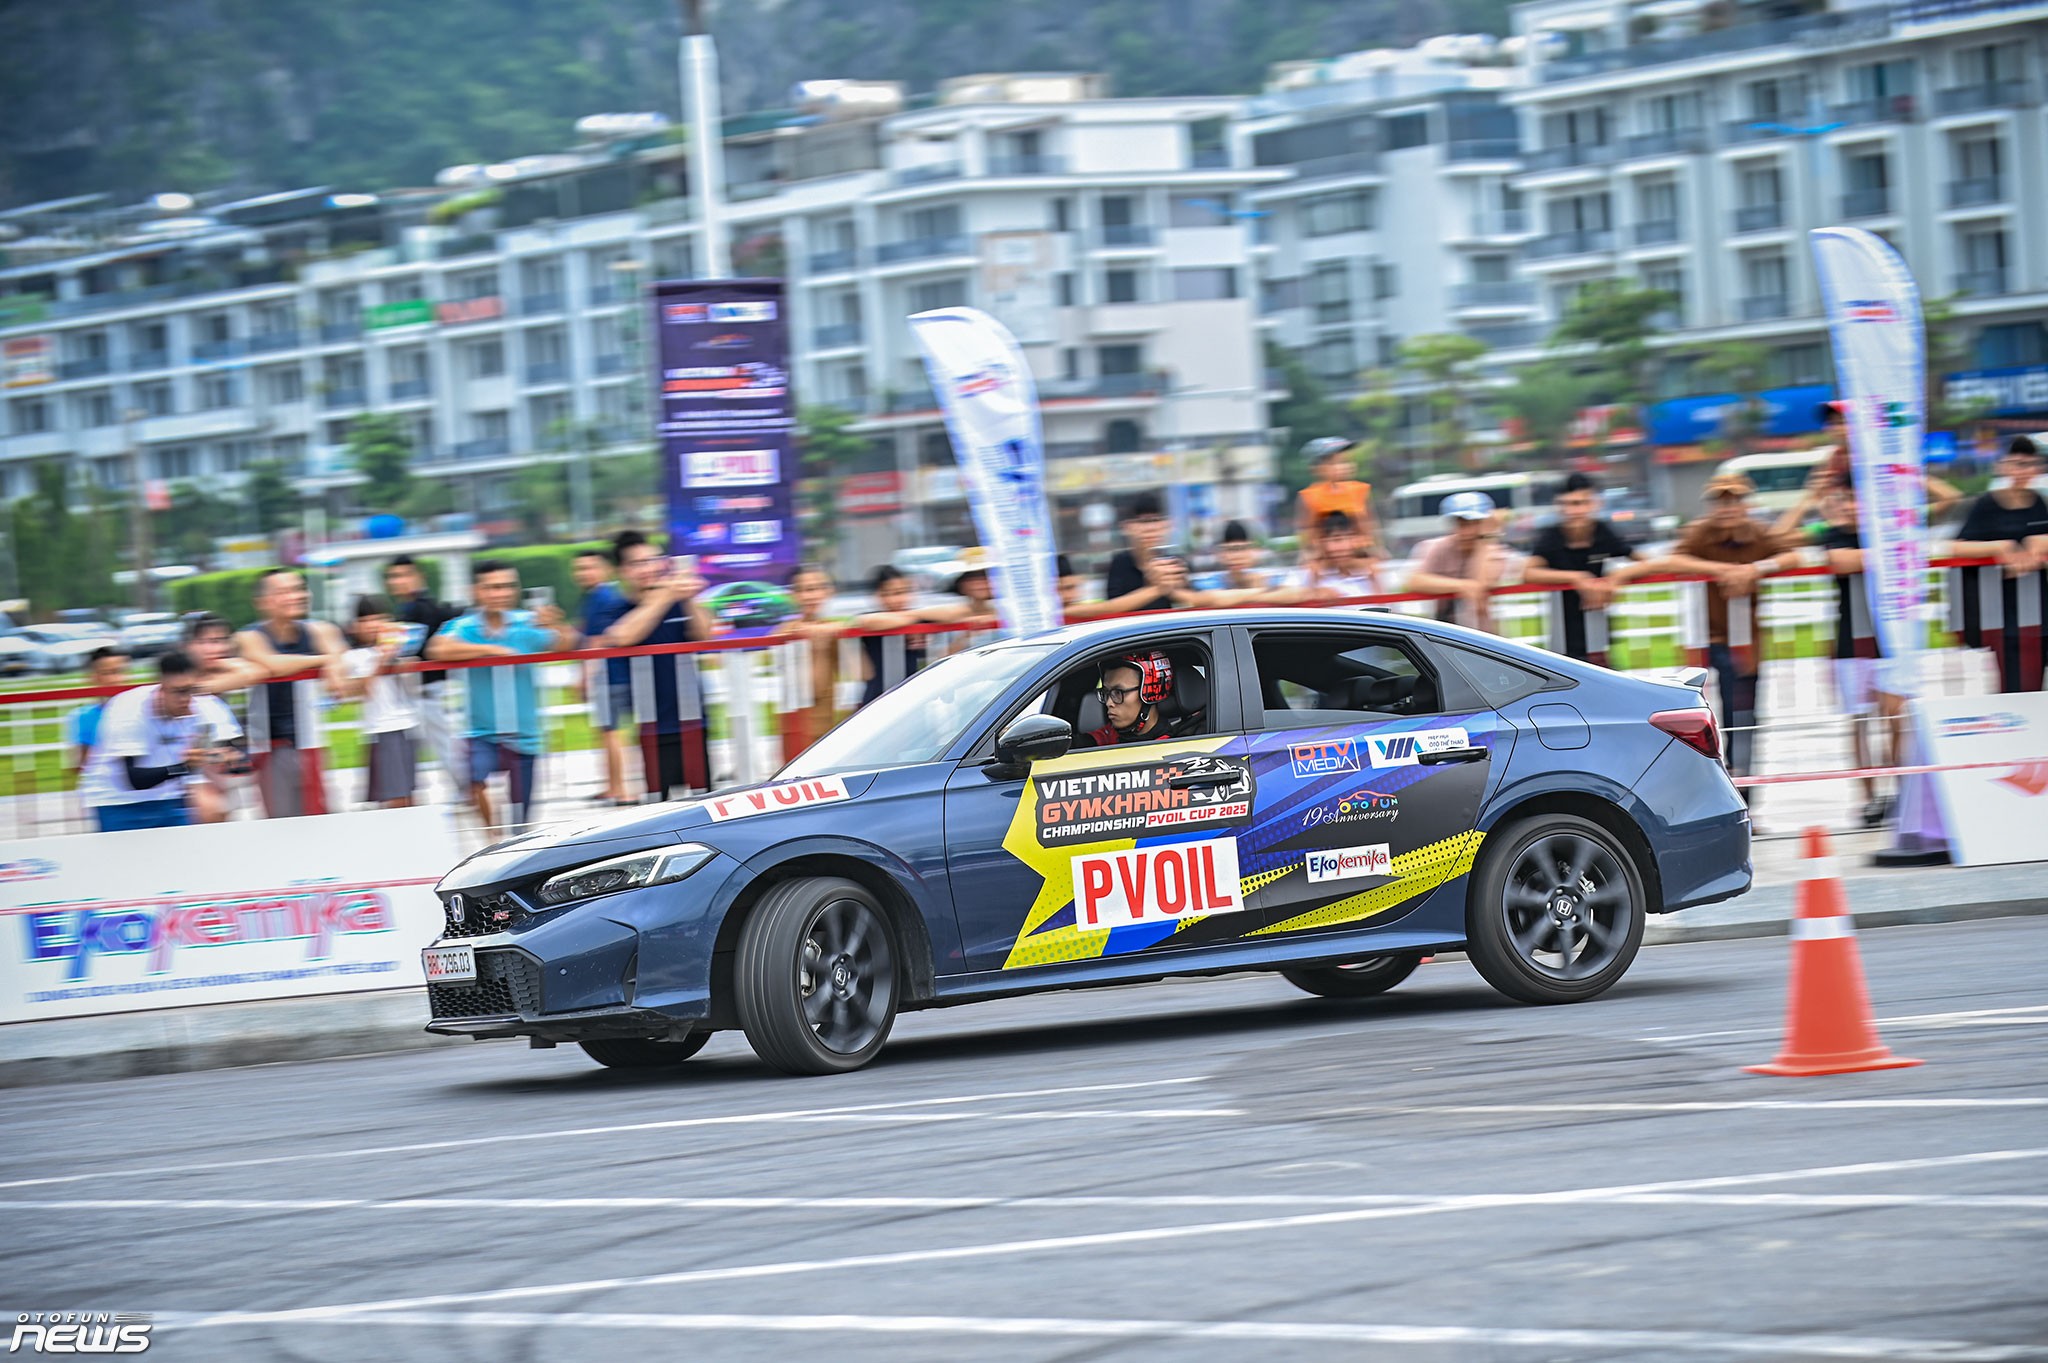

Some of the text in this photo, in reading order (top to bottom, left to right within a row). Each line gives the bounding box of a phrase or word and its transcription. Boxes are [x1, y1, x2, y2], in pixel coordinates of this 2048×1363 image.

[1294, 741, 1351, 761] OTV
[1297, 755, 1357, 773] MEDIA
[1041, 769, 1150, 799] VIETNAM
[1042, 788, 1189, 824] GYMKHANA
[1323, 808, 1399, 825] Anniversary
[1339, 798, 1398, 813] OTOFUN
[1042, 804, 1247, 839] CHAMPIONSHIP PVOIL CUP 2025
[1309, 848, 1387, 878] Ekokemika
[1082, 845, 1233, 925] PVOIL
[493, 910, 510, 921] RS
